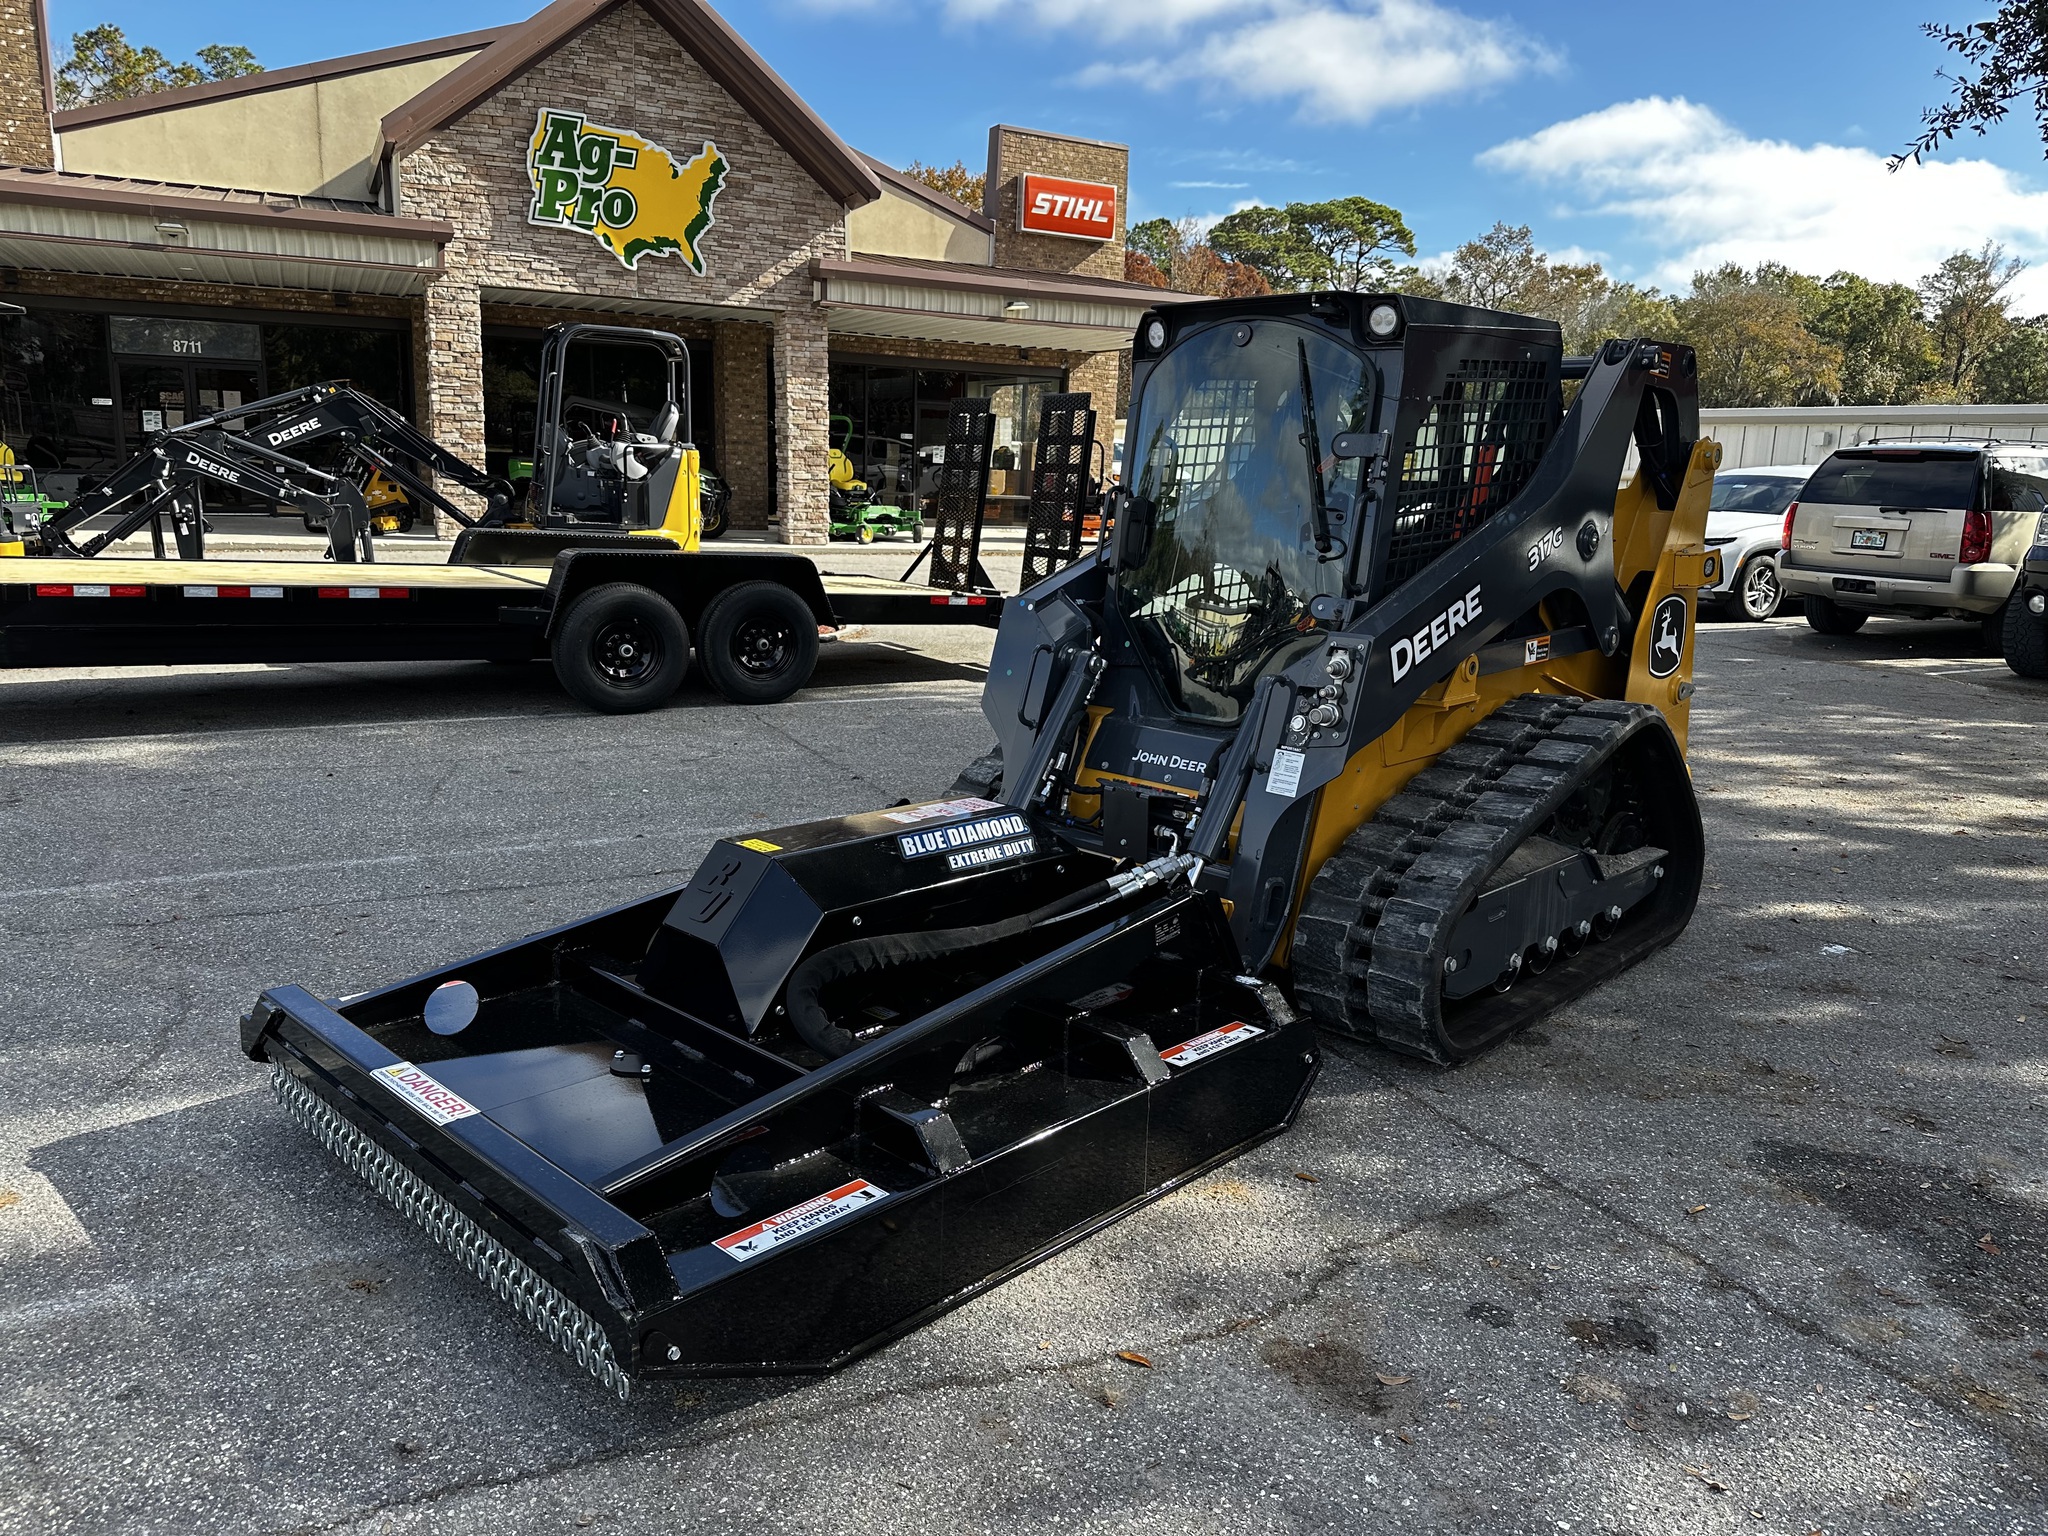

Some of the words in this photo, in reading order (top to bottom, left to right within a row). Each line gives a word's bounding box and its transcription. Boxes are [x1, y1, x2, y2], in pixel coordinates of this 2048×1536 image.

[535, 113, 637, 184] Ag-
[535, 168, 636, 227] Pro
[1031, 192, 1109, 223] STIHL
[172, 339, 202, 354] 8711
[267, 417, 322, 446] DEERE
[186, 452, 240, 483] DEERE
[1527, 526, 1564, 572] 317G
[1930, 552, 1955, 560] GMC
[1390, 583, 1483, 684] DEERE
[1132, 749, 1168, 766] JOHN
[1169, 755, 1207, 774] DEER
[901, 831, 947, 856] BLUE
[949, 846, 1003, 869] EXTREME
[1004, 838, 1035, 858] DUTY
[398, 1072, 472, 1117] DANGER!
[771, 1196, 833, 1224] WARNING
[772, 1219, 800, 1234] KEEP
[800, 1204, 838, 1222] HANDS
[773, 1230, 796, 1242] AND
[798, 1217, 822, 1232] FEET
[823, 1204, 852, 1221] AWAY
